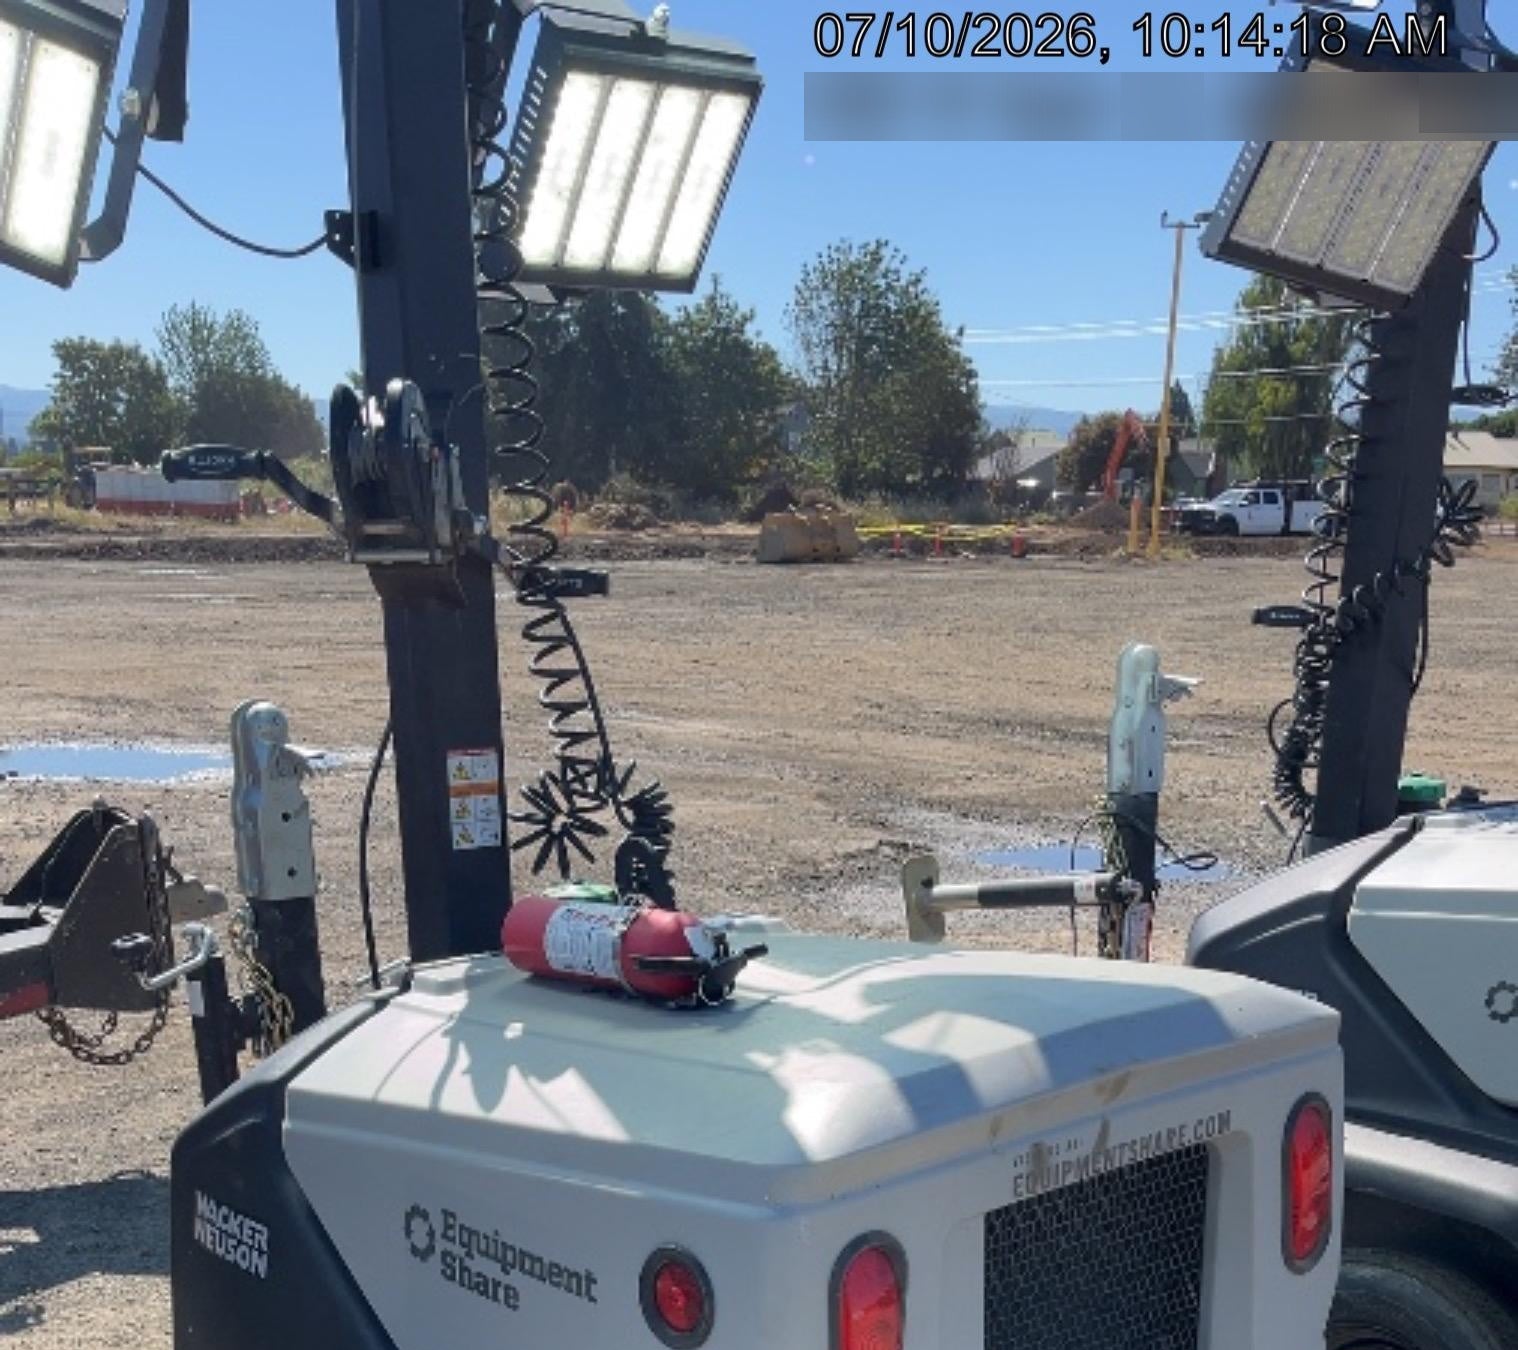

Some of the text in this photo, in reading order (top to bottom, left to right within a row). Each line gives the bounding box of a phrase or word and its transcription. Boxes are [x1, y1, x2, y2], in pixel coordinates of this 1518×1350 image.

[194, 1190, 268, 1251] WACKER
[194, 1216, 268, 1279] NEUSON
[441, 1208, 599, 1305] Equipment
[441, 1248, 520, 1312] Share
